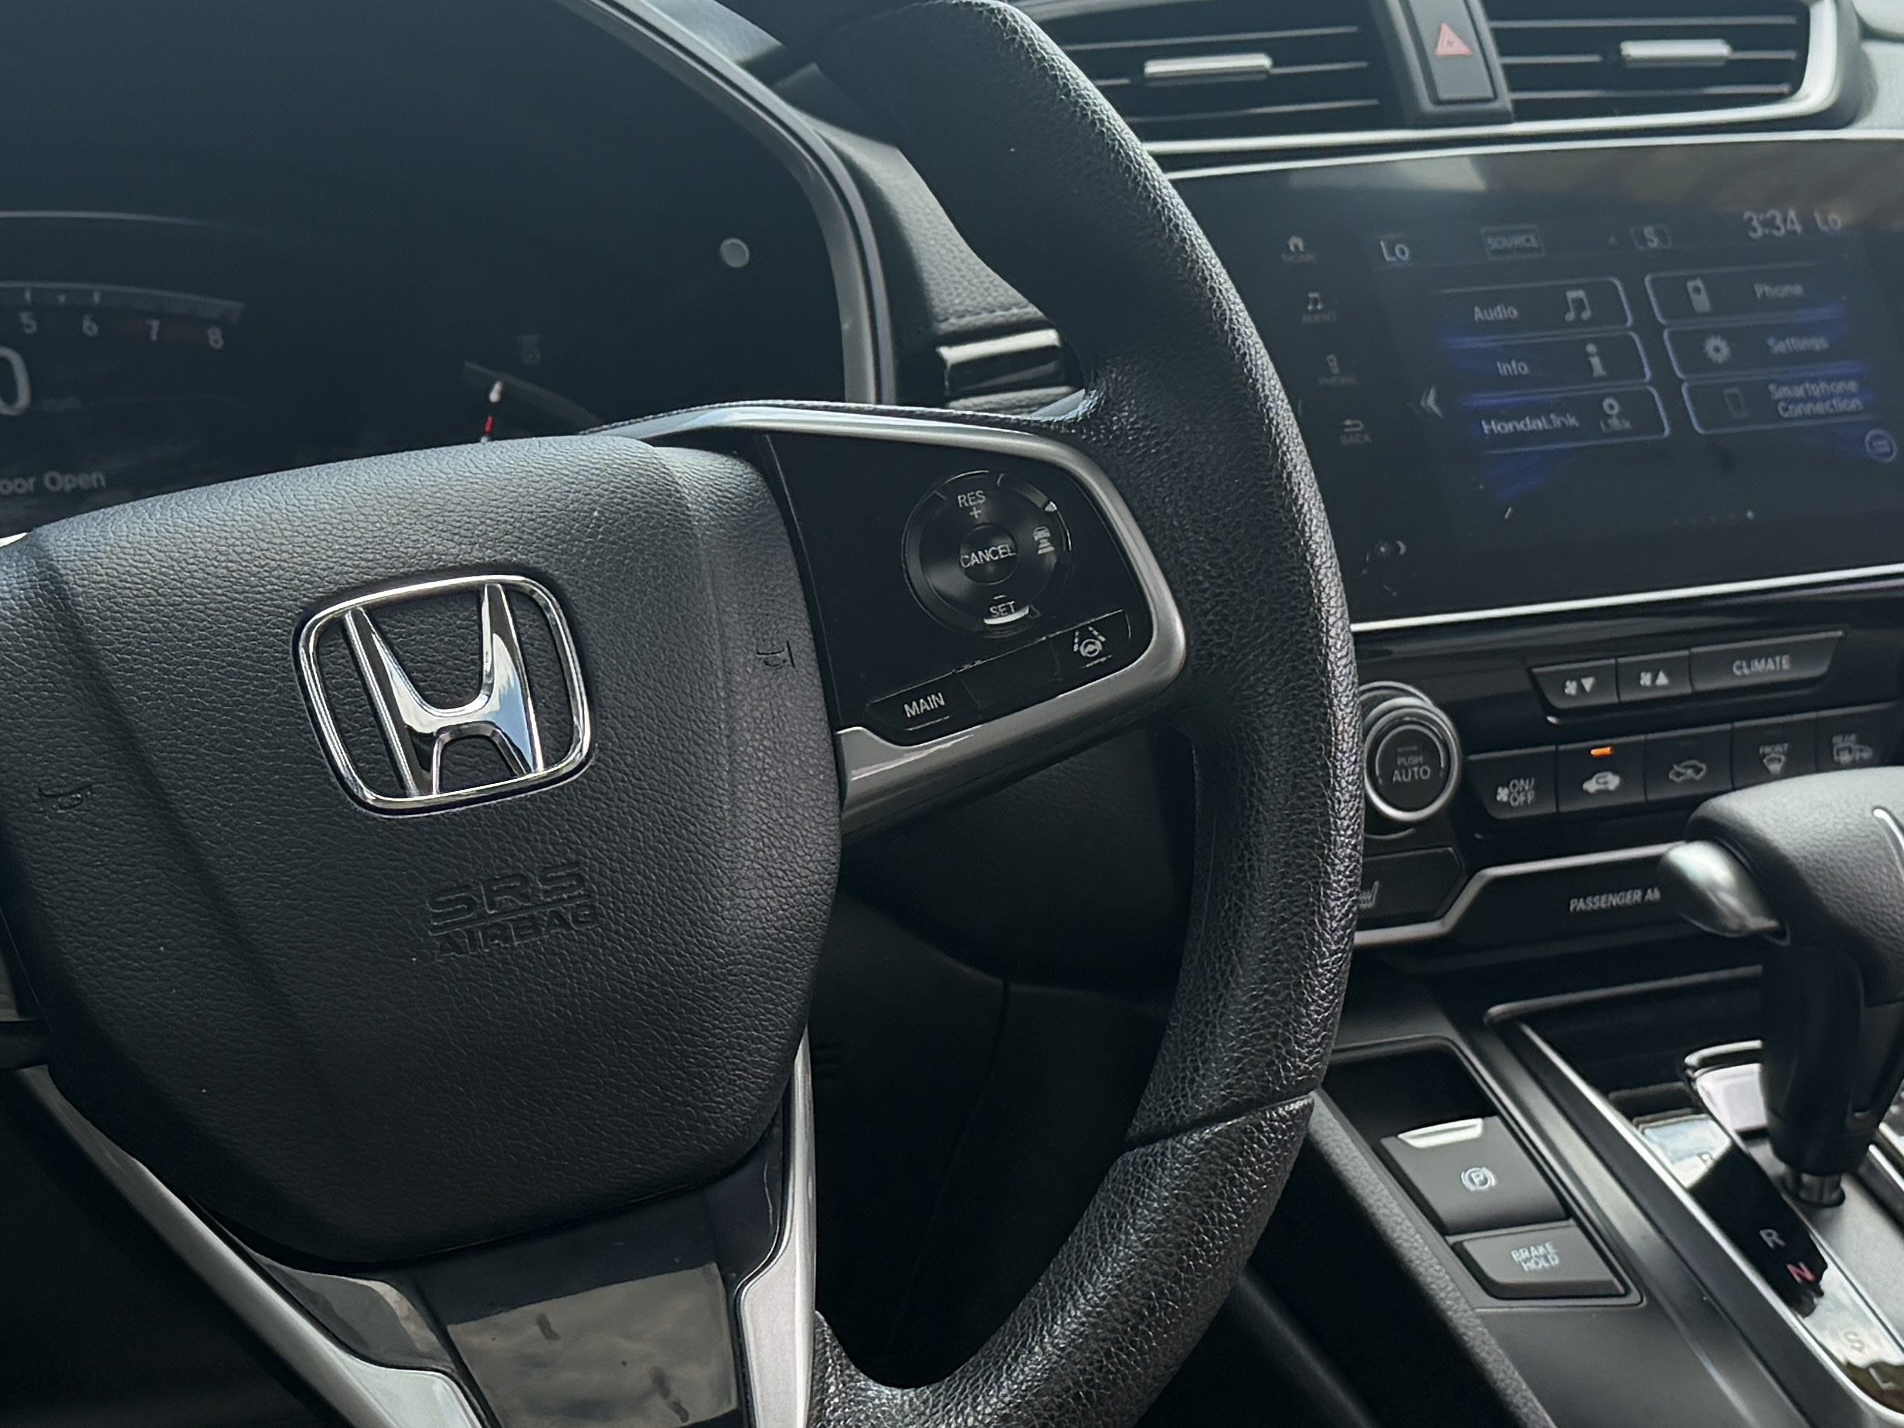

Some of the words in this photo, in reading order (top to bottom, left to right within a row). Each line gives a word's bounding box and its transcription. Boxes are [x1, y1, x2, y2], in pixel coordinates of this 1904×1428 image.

[1743, 208, 1802, 239] 3:34
[1380, 239, 1410, 262] Lo
[1754, 282, 1804, 300] Phone
[19, 311, 38, 335] 5
[1473, 303, 1519, 324] Audio
[82, 314, 99, 337] 6
[144, 317, 161, 341] 7
[207, 326, 225, 351] 8
[1766, 335, 1830, 356] Settings
[1496, 359, 1530, 377] Info
[1767, 378, 1859, 401] Smartphone
[1778, 397, 1864, 419] Connection
[1481, 410, 1580, 436] HondaLink
[42, 469, 107, 497] Open
[957, 489, 987, 508] RES
[959, 544, 1017, 569] CANCEL
[989, 600, 1016, 618] SET
[1732, 654, 1792, 677] CLIMATE
[903, 692, 946, 719] MAIN
[1397, 754, 1423, 767] PUSH
[1759, 743, 1789, 755] FRONT
[1392, 766, 1432, 784] AUTO
[1509, 777, 1536, 793] ON/
[1509, 790, 1536, 808] OFF
[426, 862, 589, 929] SRS
[1569, 887, 1643, 914] PASSENGER
[1758, 1228, 1787, 1251] R
[1511, 1241, 1558, 1265] BRAKE
[1520, 1253, 1561, 1273] HOLD
[1786, 1260, 1818, 1284] N
